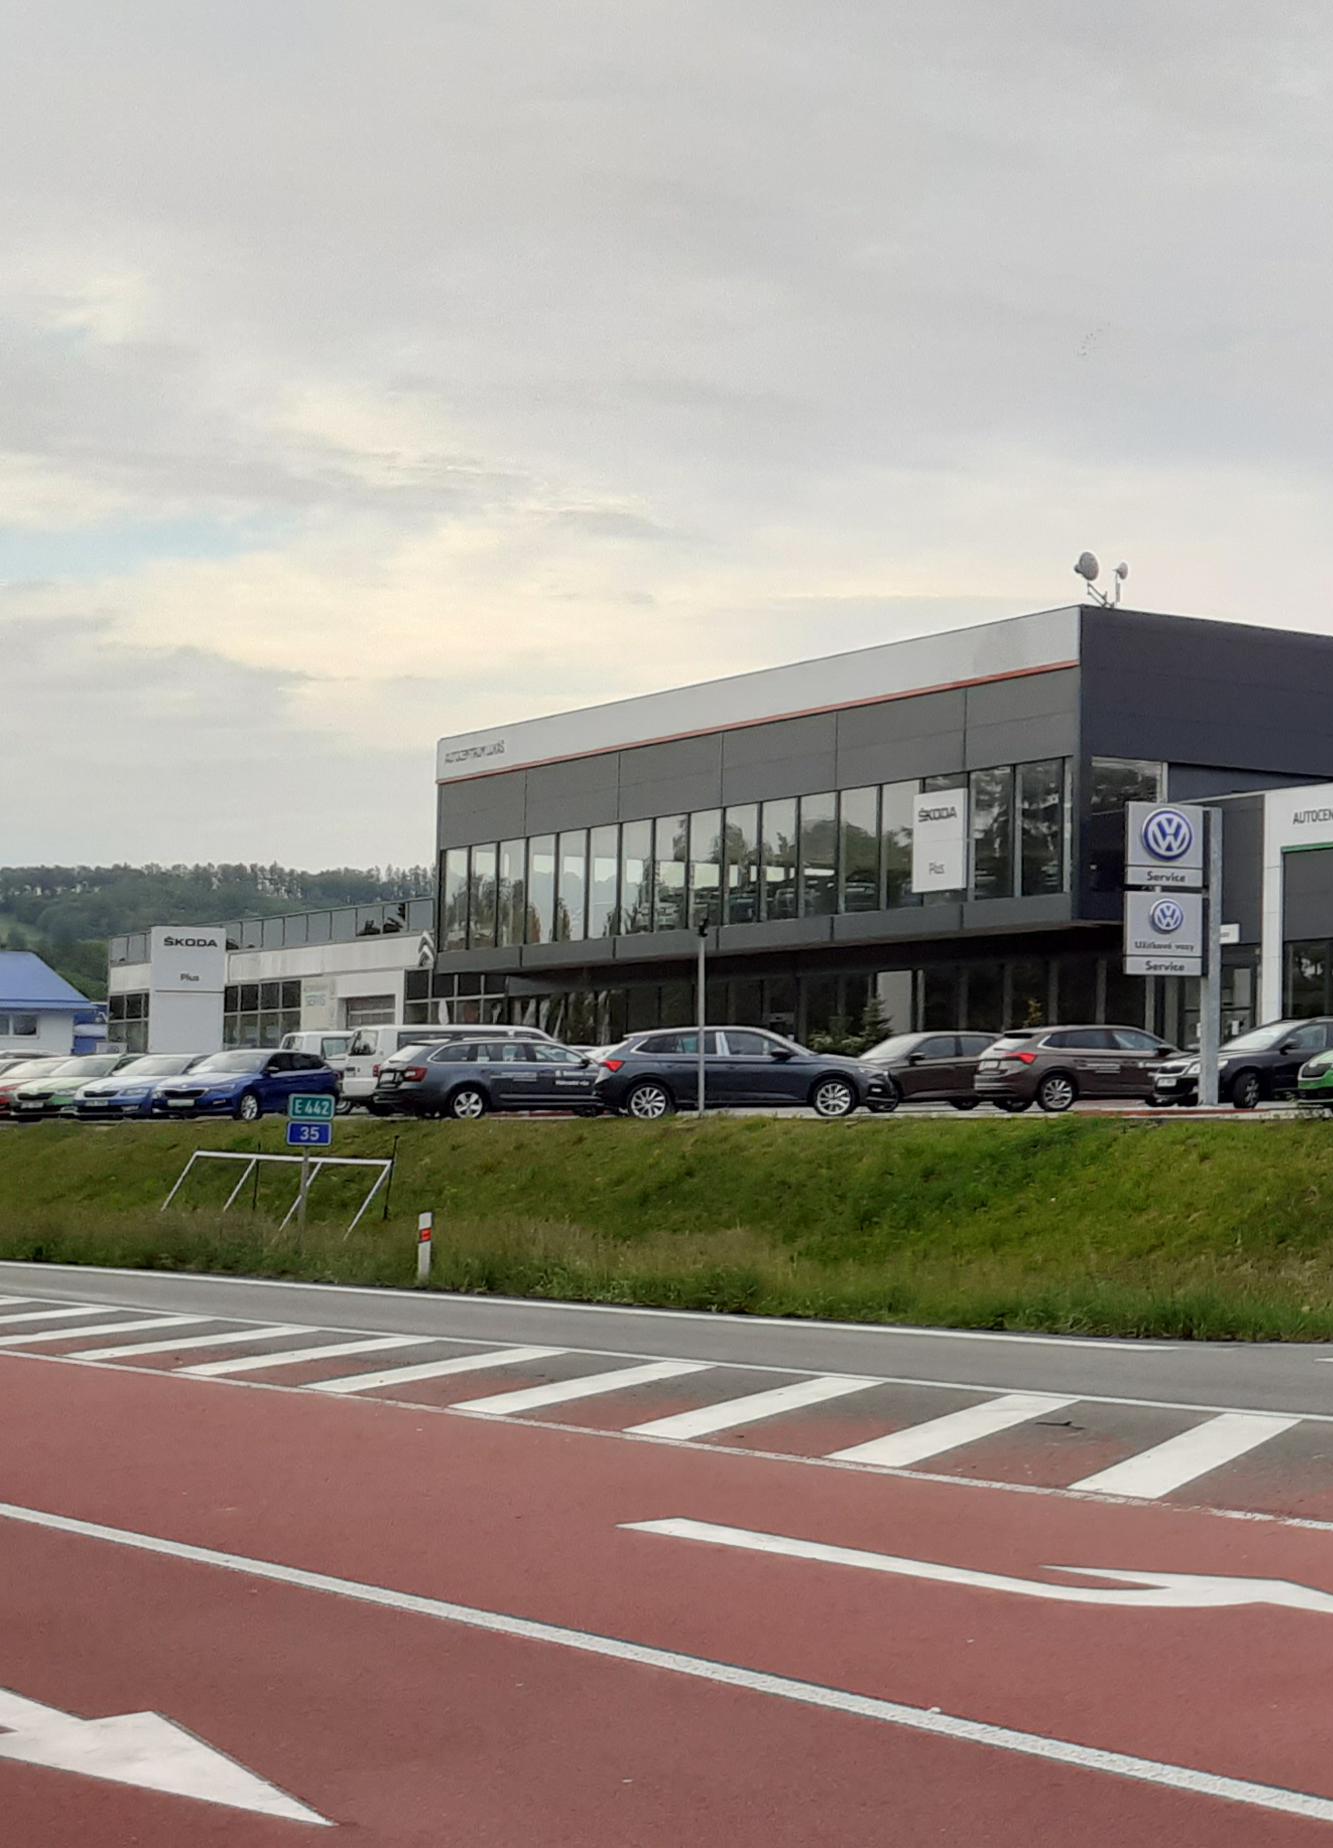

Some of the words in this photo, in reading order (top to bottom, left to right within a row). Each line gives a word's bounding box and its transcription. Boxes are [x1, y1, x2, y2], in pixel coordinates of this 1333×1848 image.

[1147, 871, 1186, 883] Service
[163, 937, 218, 947] ŠKODA
[1145, 960, 1185, 971] Service
[180, 973, 200, 981] Plus
[294, 1100, 303, 1114] E
[304, 1100, 330, 1115] 442
[299, 1126, 320, 1140] 35
